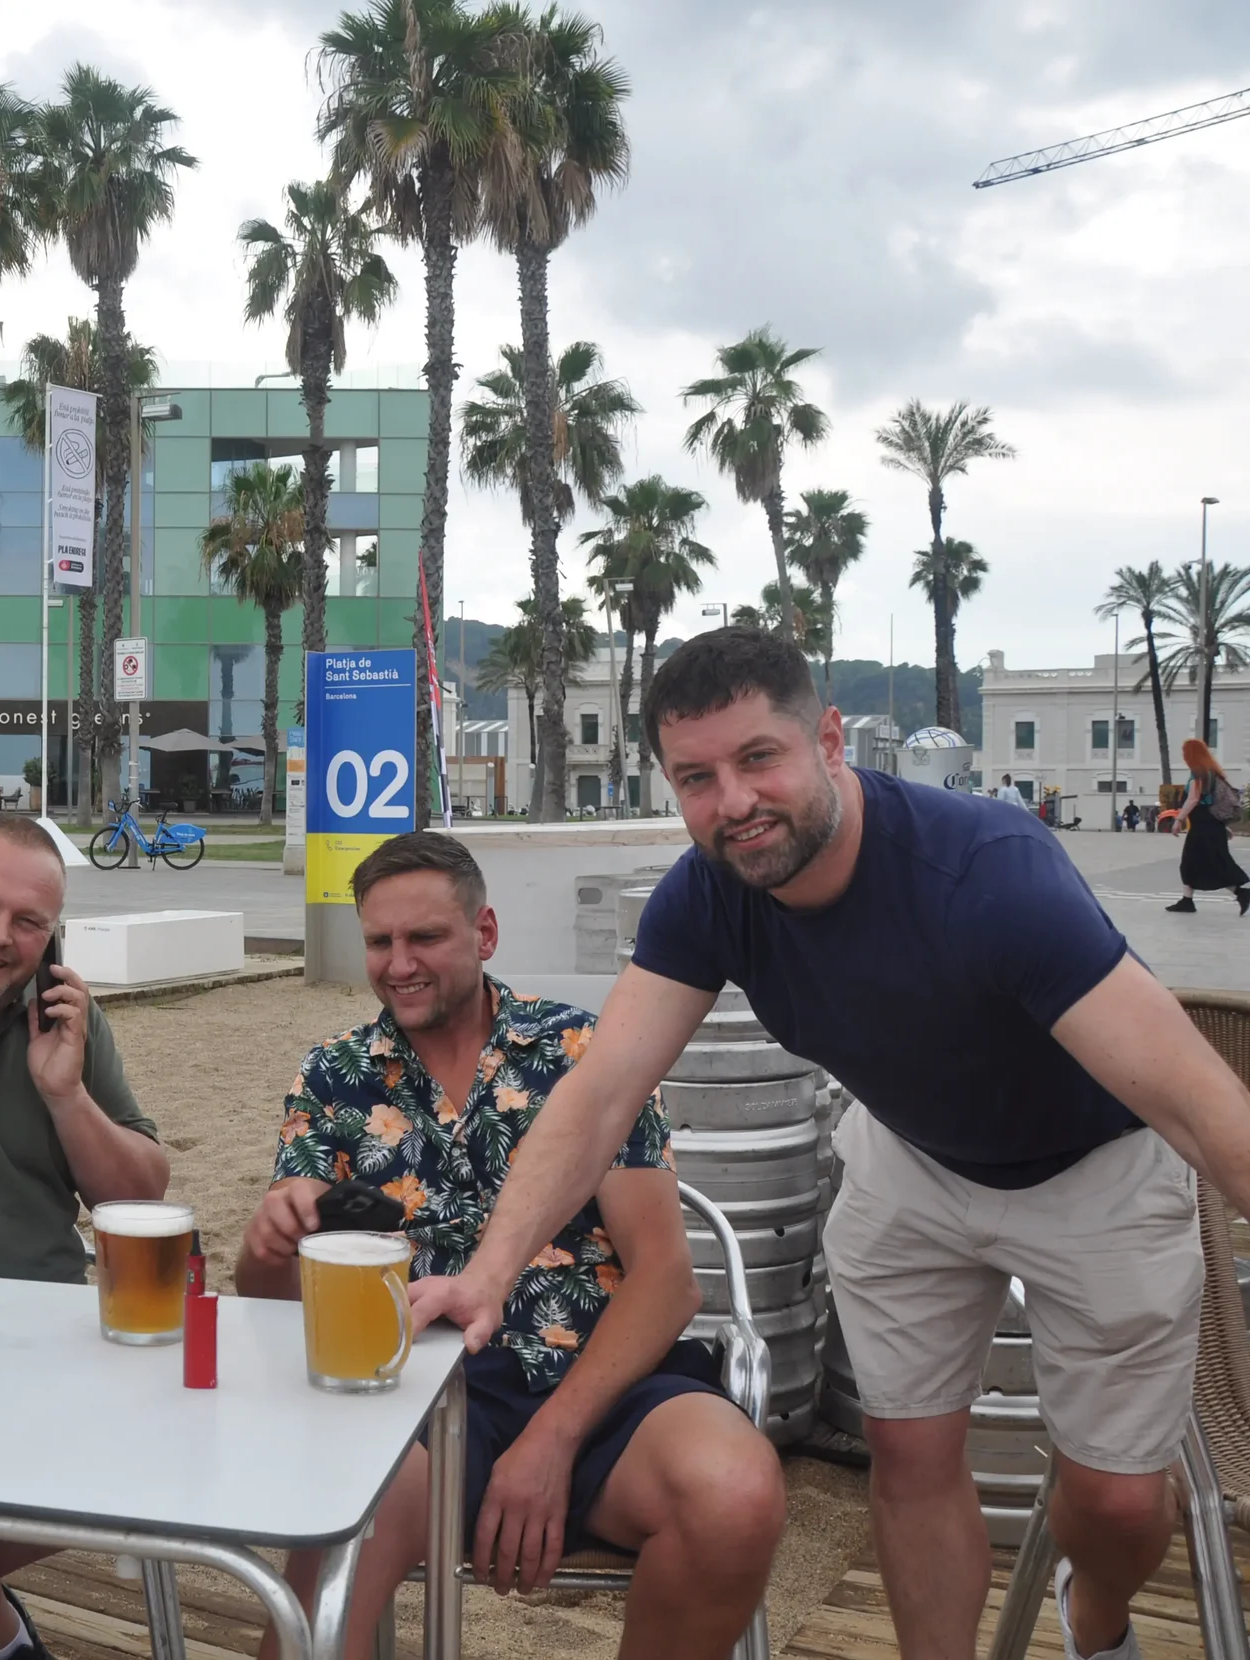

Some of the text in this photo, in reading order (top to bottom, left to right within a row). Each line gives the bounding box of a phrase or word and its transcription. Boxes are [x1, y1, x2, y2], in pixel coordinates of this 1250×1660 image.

[325, 657, 371, 671] Platja de
[325, 668, 399, 681] Sant Sebastià
[325, 692, 357, 700] Barcelona
[326, 749, 410, 818] 02
